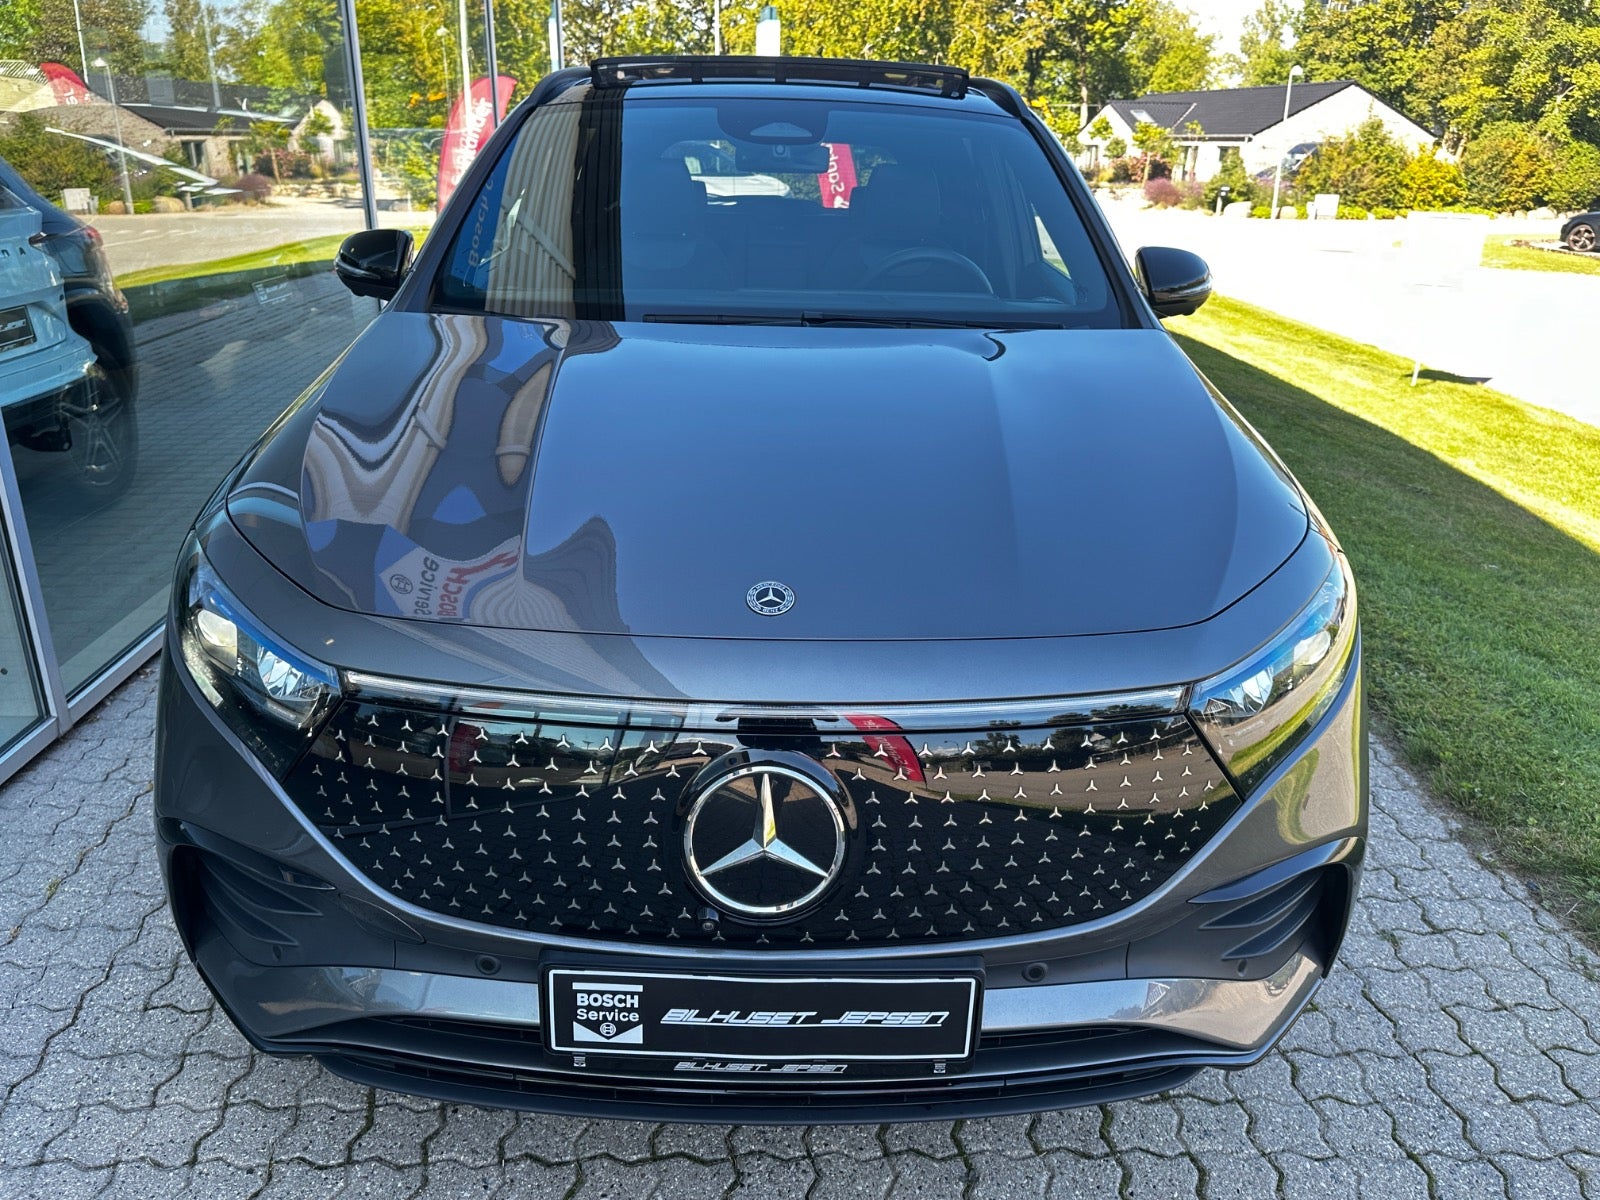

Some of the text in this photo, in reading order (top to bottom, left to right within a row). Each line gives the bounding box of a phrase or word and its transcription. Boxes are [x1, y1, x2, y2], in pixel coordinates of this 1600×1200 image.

[576, 992, 639, 1008] BOSCH
[576, 1008, 640, 1022] Service
[661, 1008, 950, 1025] BILHUSET JEPSEN
[673, 1061, 848, 1073] BILHUSET JEPSEN
